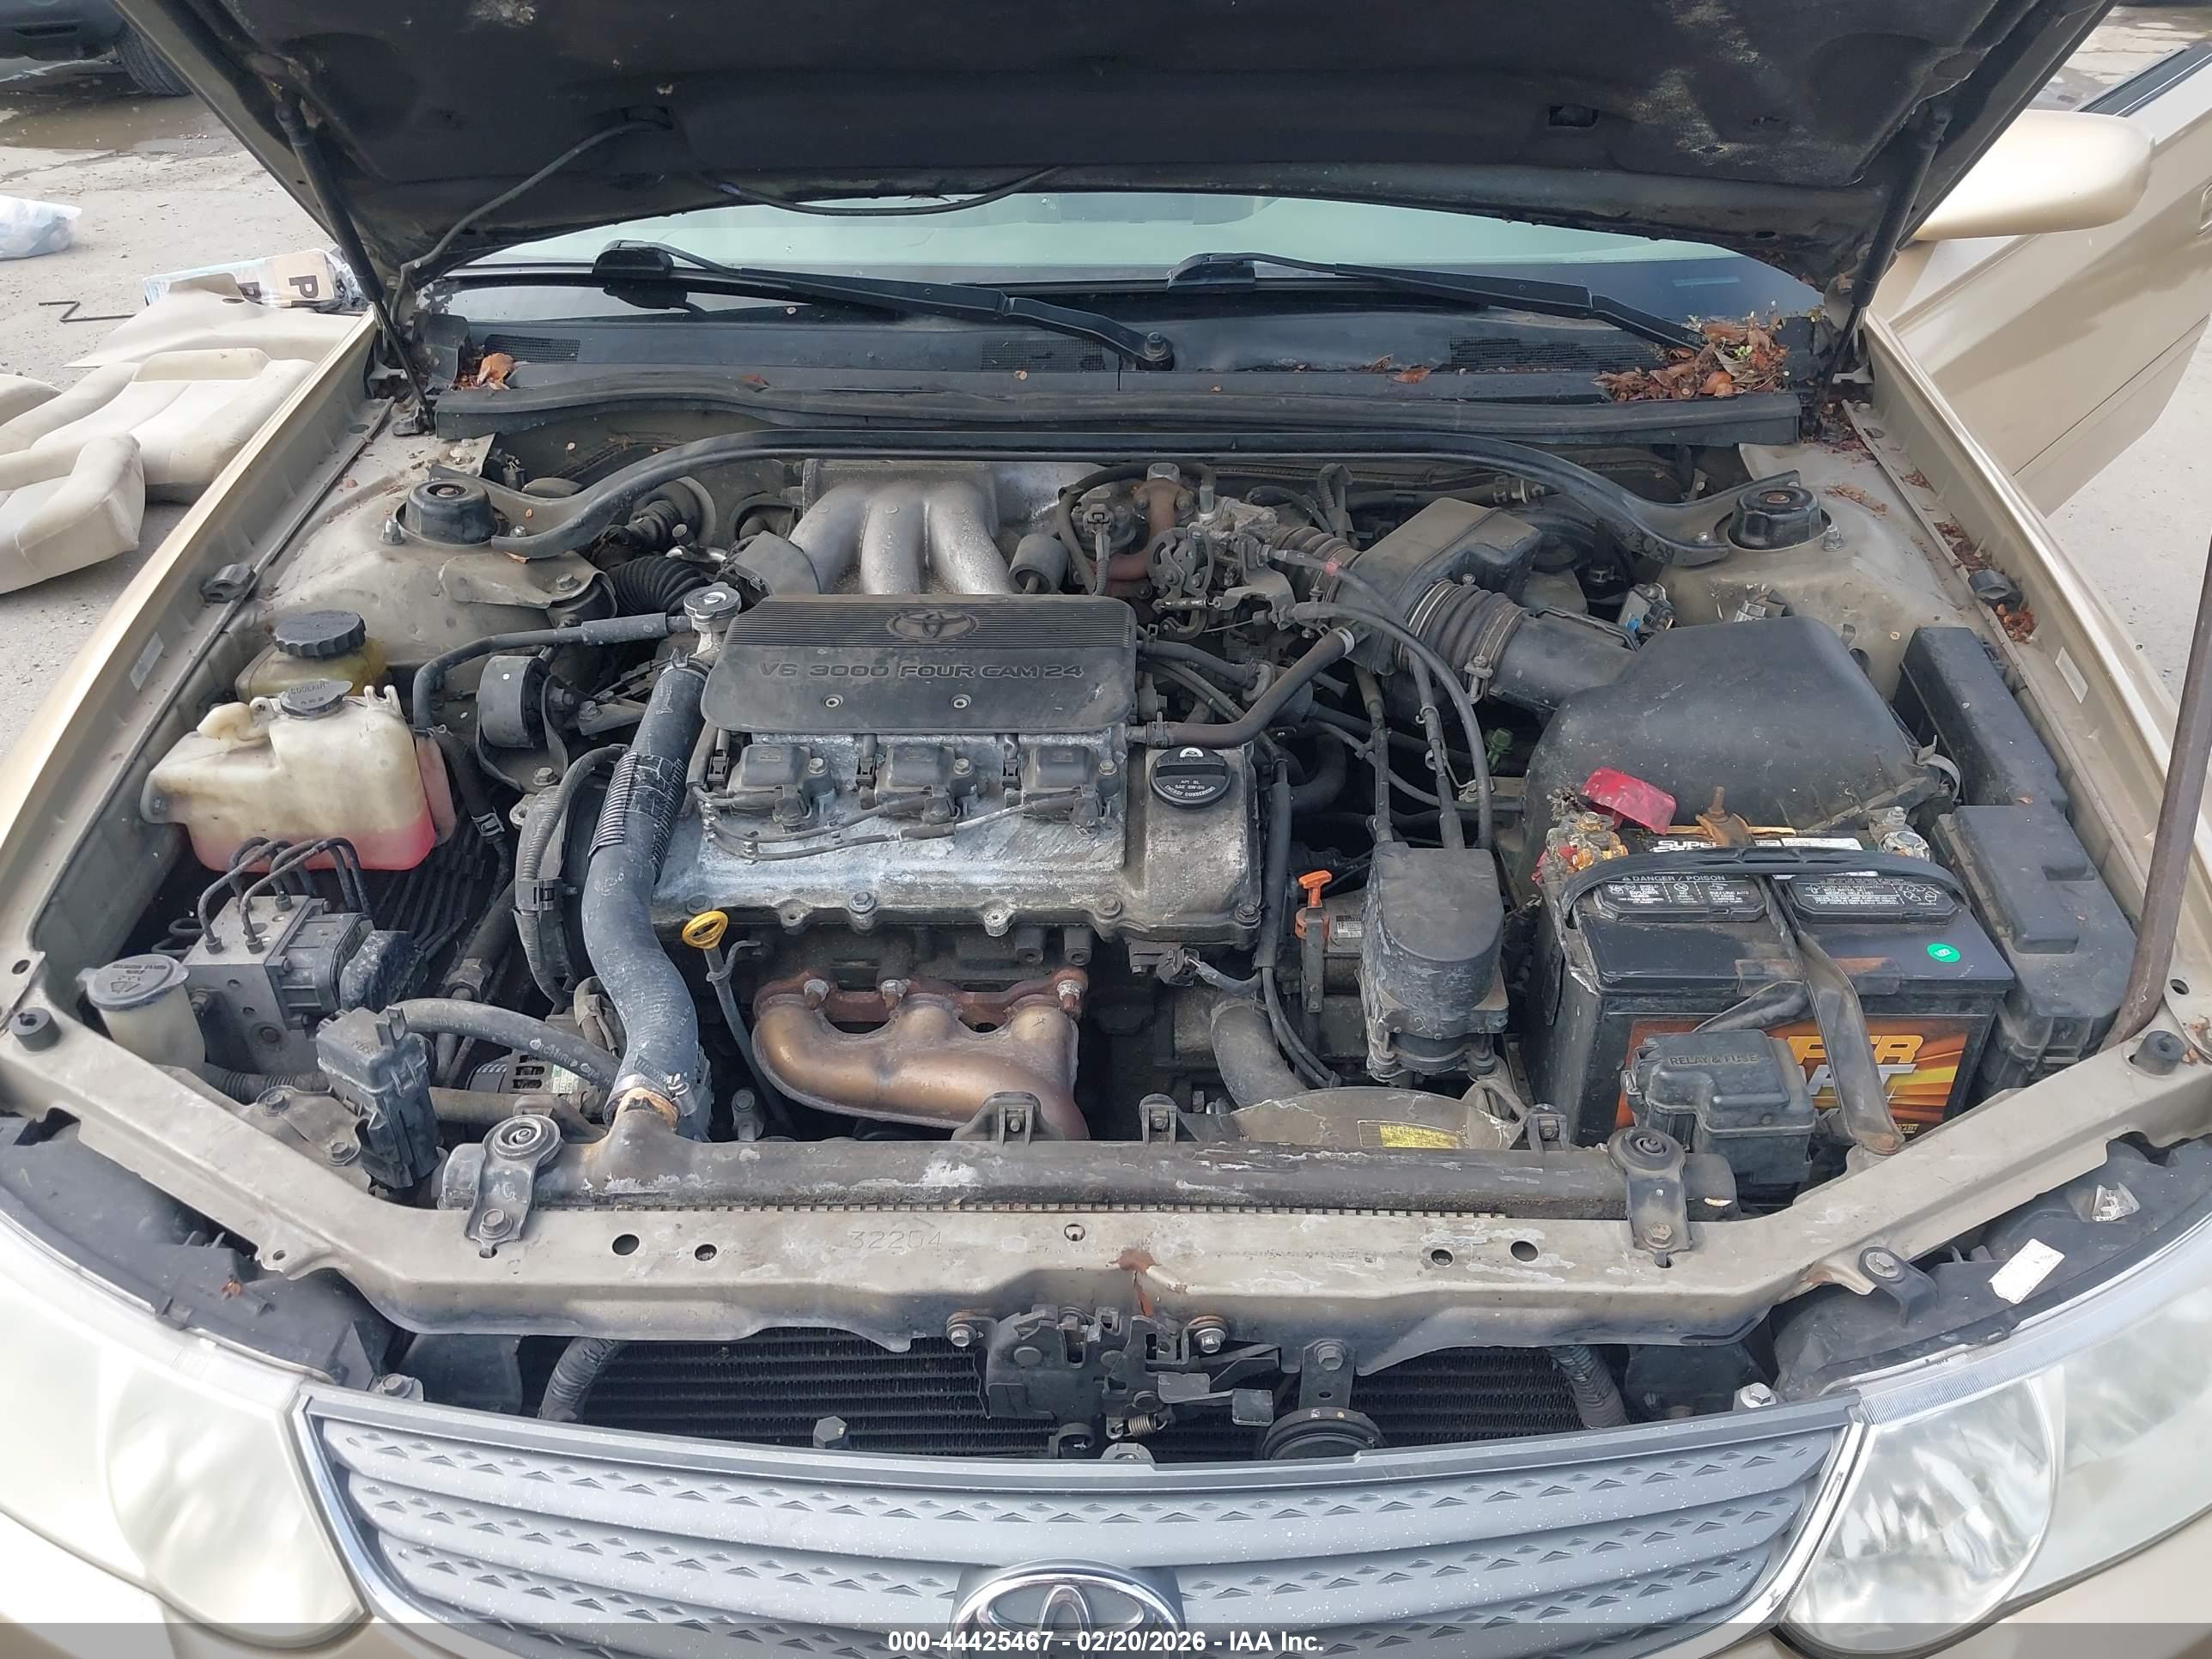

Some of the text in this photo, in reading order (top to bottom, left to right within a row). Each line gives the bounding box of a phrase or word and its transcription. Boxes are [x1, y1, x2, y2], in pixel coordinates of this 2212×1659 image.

[760, 662, 1084, 680] V6 3000 FOUR CAM 24
[1669, 1054, 1759, 1066] RELAY & FUSE
